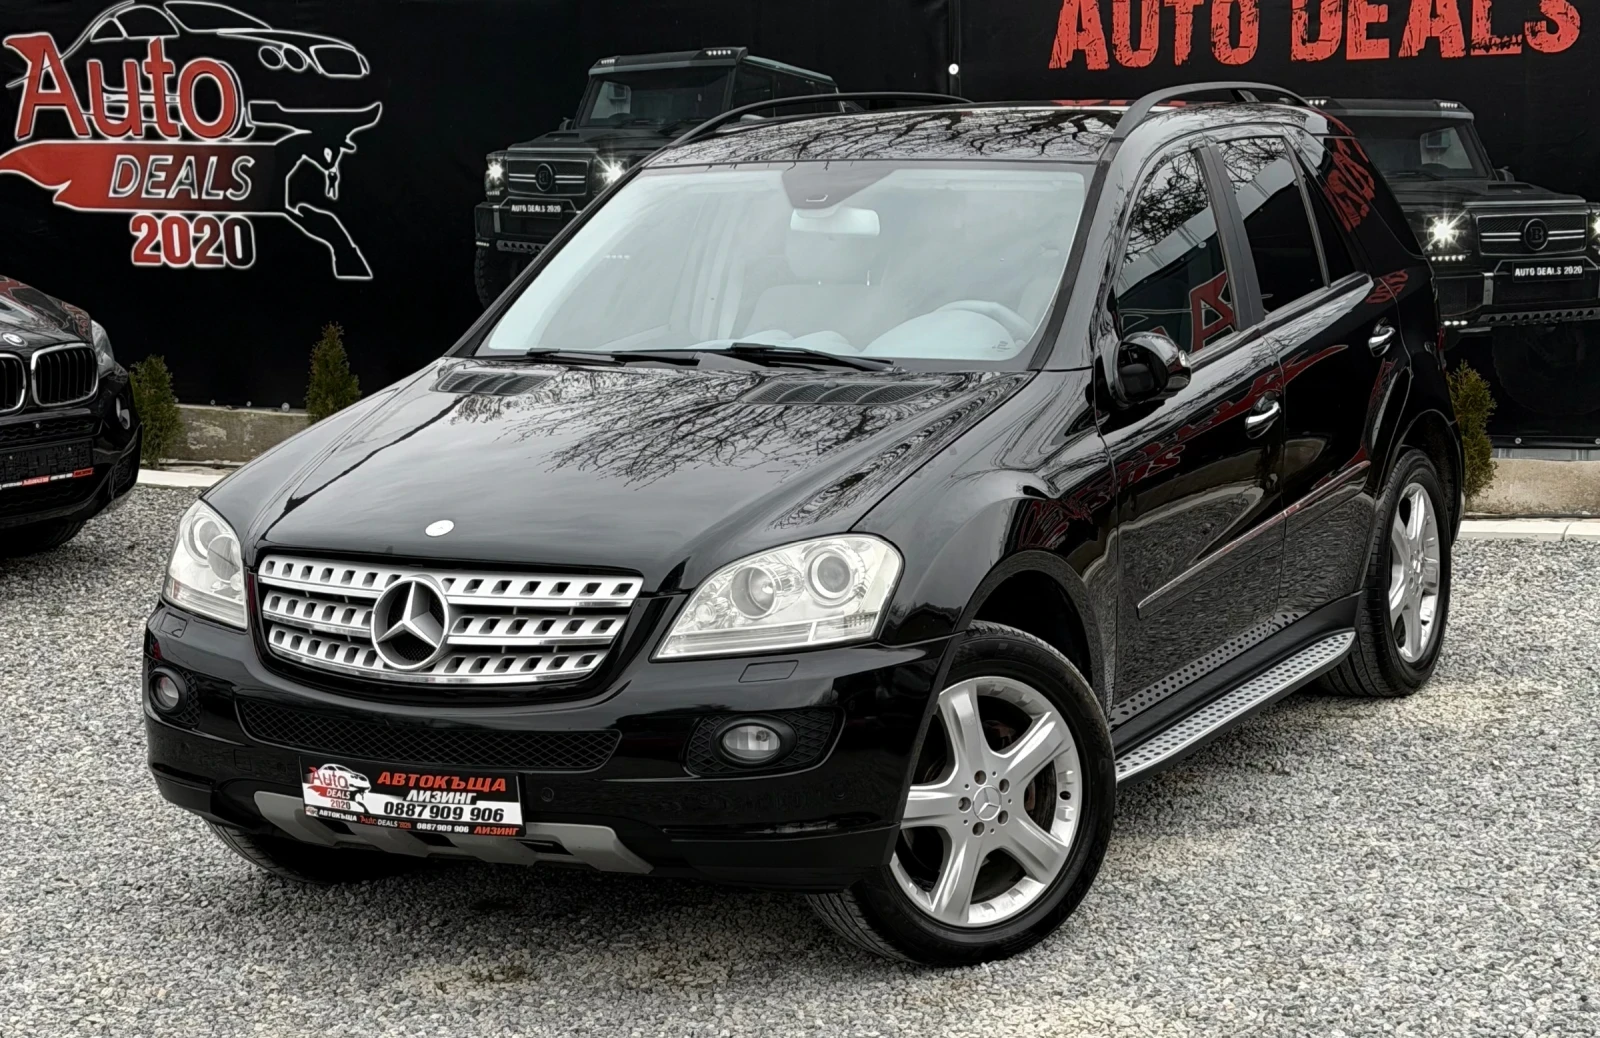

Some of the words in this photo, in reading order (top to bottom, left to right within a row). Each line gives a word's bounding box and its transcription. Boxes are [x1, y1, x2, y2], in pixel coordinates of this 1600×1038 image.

[1048, 0, 1259, 70] AUTO
[1291, 0, 1581, 61] DEALS
[3, 32, 241, 141] Auto
[108, 154, 255, 200] DEALS
[528, 204, 546, 212] DEALS
[130, 212, 256, 268] 2020
[1514, 267, 1535, 277] AUTO
[1536, 266, 1562, 276] DEALS
[1563, 265, 1583, 275] 2020
[308, 766, 350, 790] Auto
[377, 771, 506, 792] АВТОКЪЩА
[326, 788, 351, 800] DEALS
[406, 789, 477, 804] ЛИЗИНГ
[330, 799, 352, 811] 2020
[319, 809, 358, 822] АВТОКЪЩА
[469, 806, 505, 823] 906
[377, 818, 398, 828] DEALS
[453, 825, 470, 834] 906
[474, 825, 519, 837] ЛИЗИНГ
